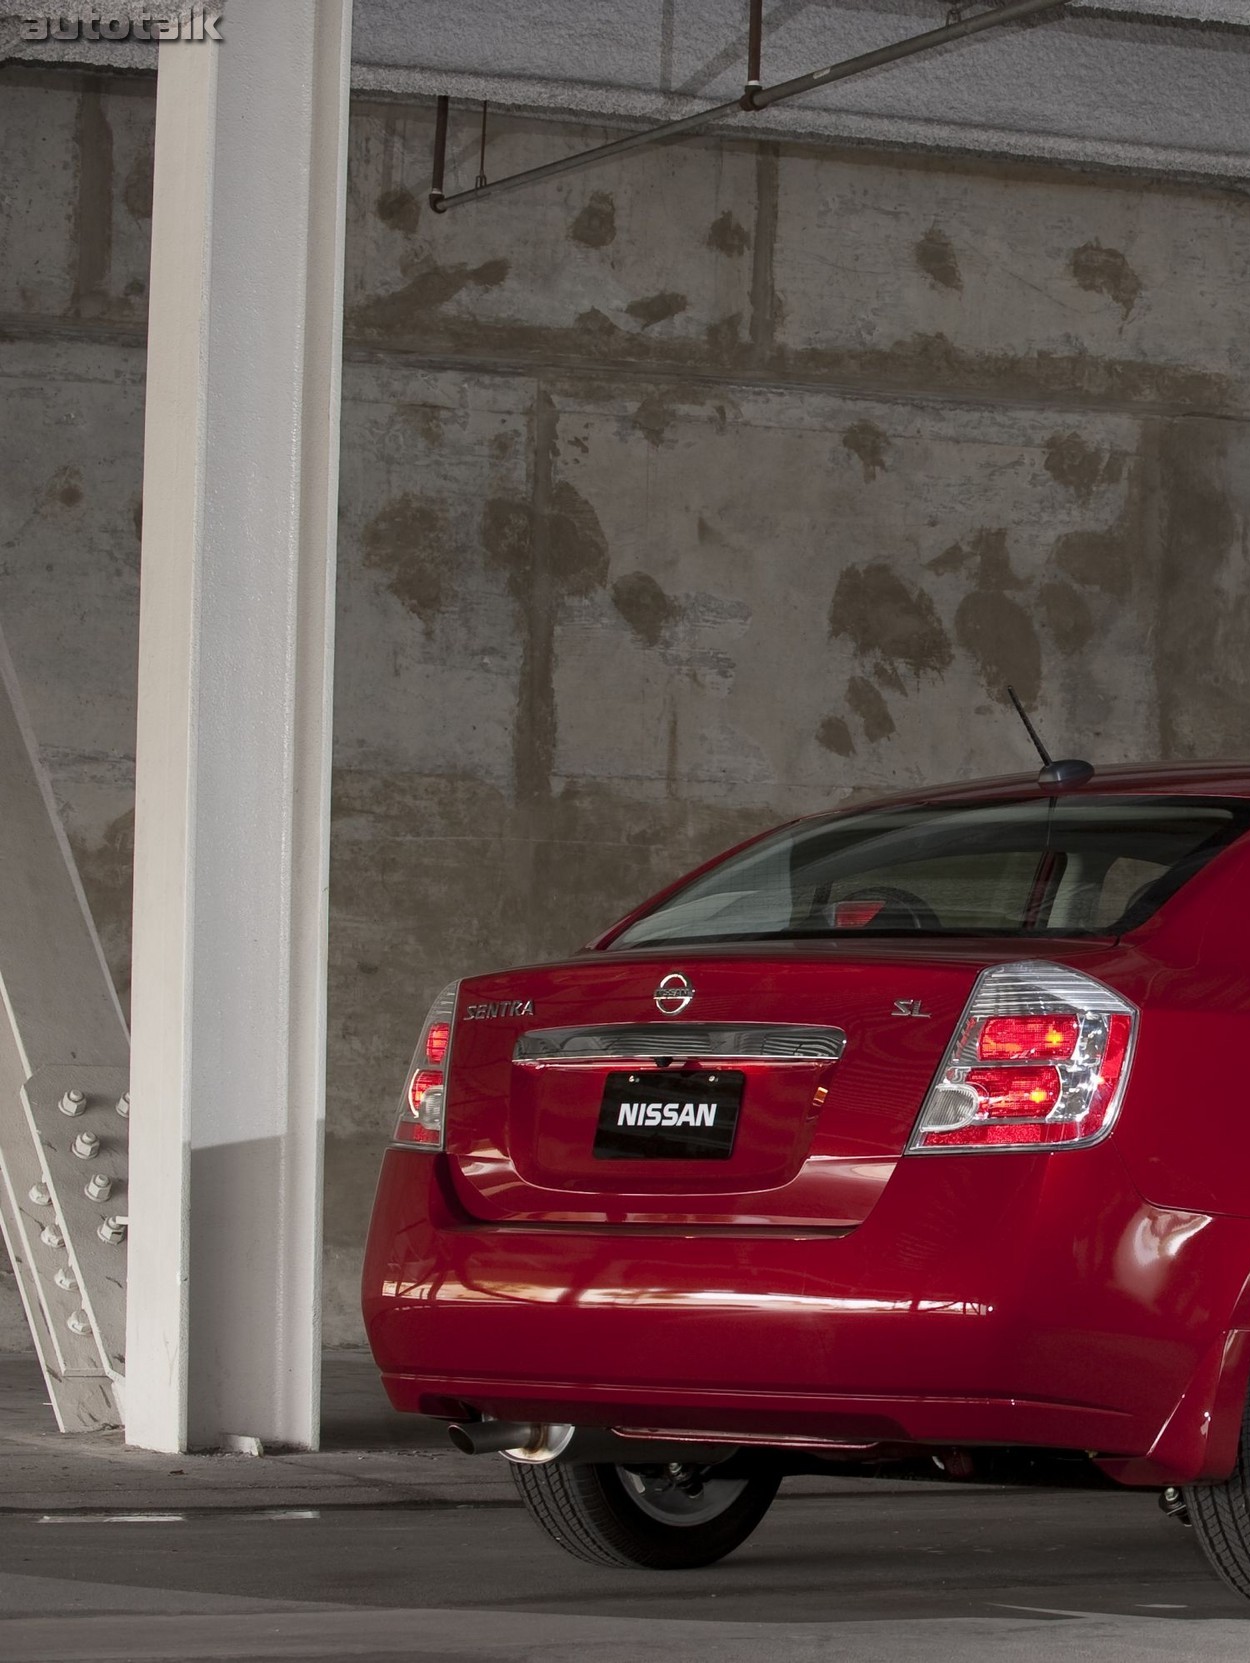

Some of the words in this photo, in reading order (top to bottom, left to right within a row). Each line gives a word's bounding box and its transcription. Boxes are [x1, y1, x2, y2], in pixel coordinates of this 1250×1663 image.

[463, 999, 534, 1020] SENTRA
[891, 999, 931, 1018] SL
[617, 1103, 718, 1127] NISSAN
